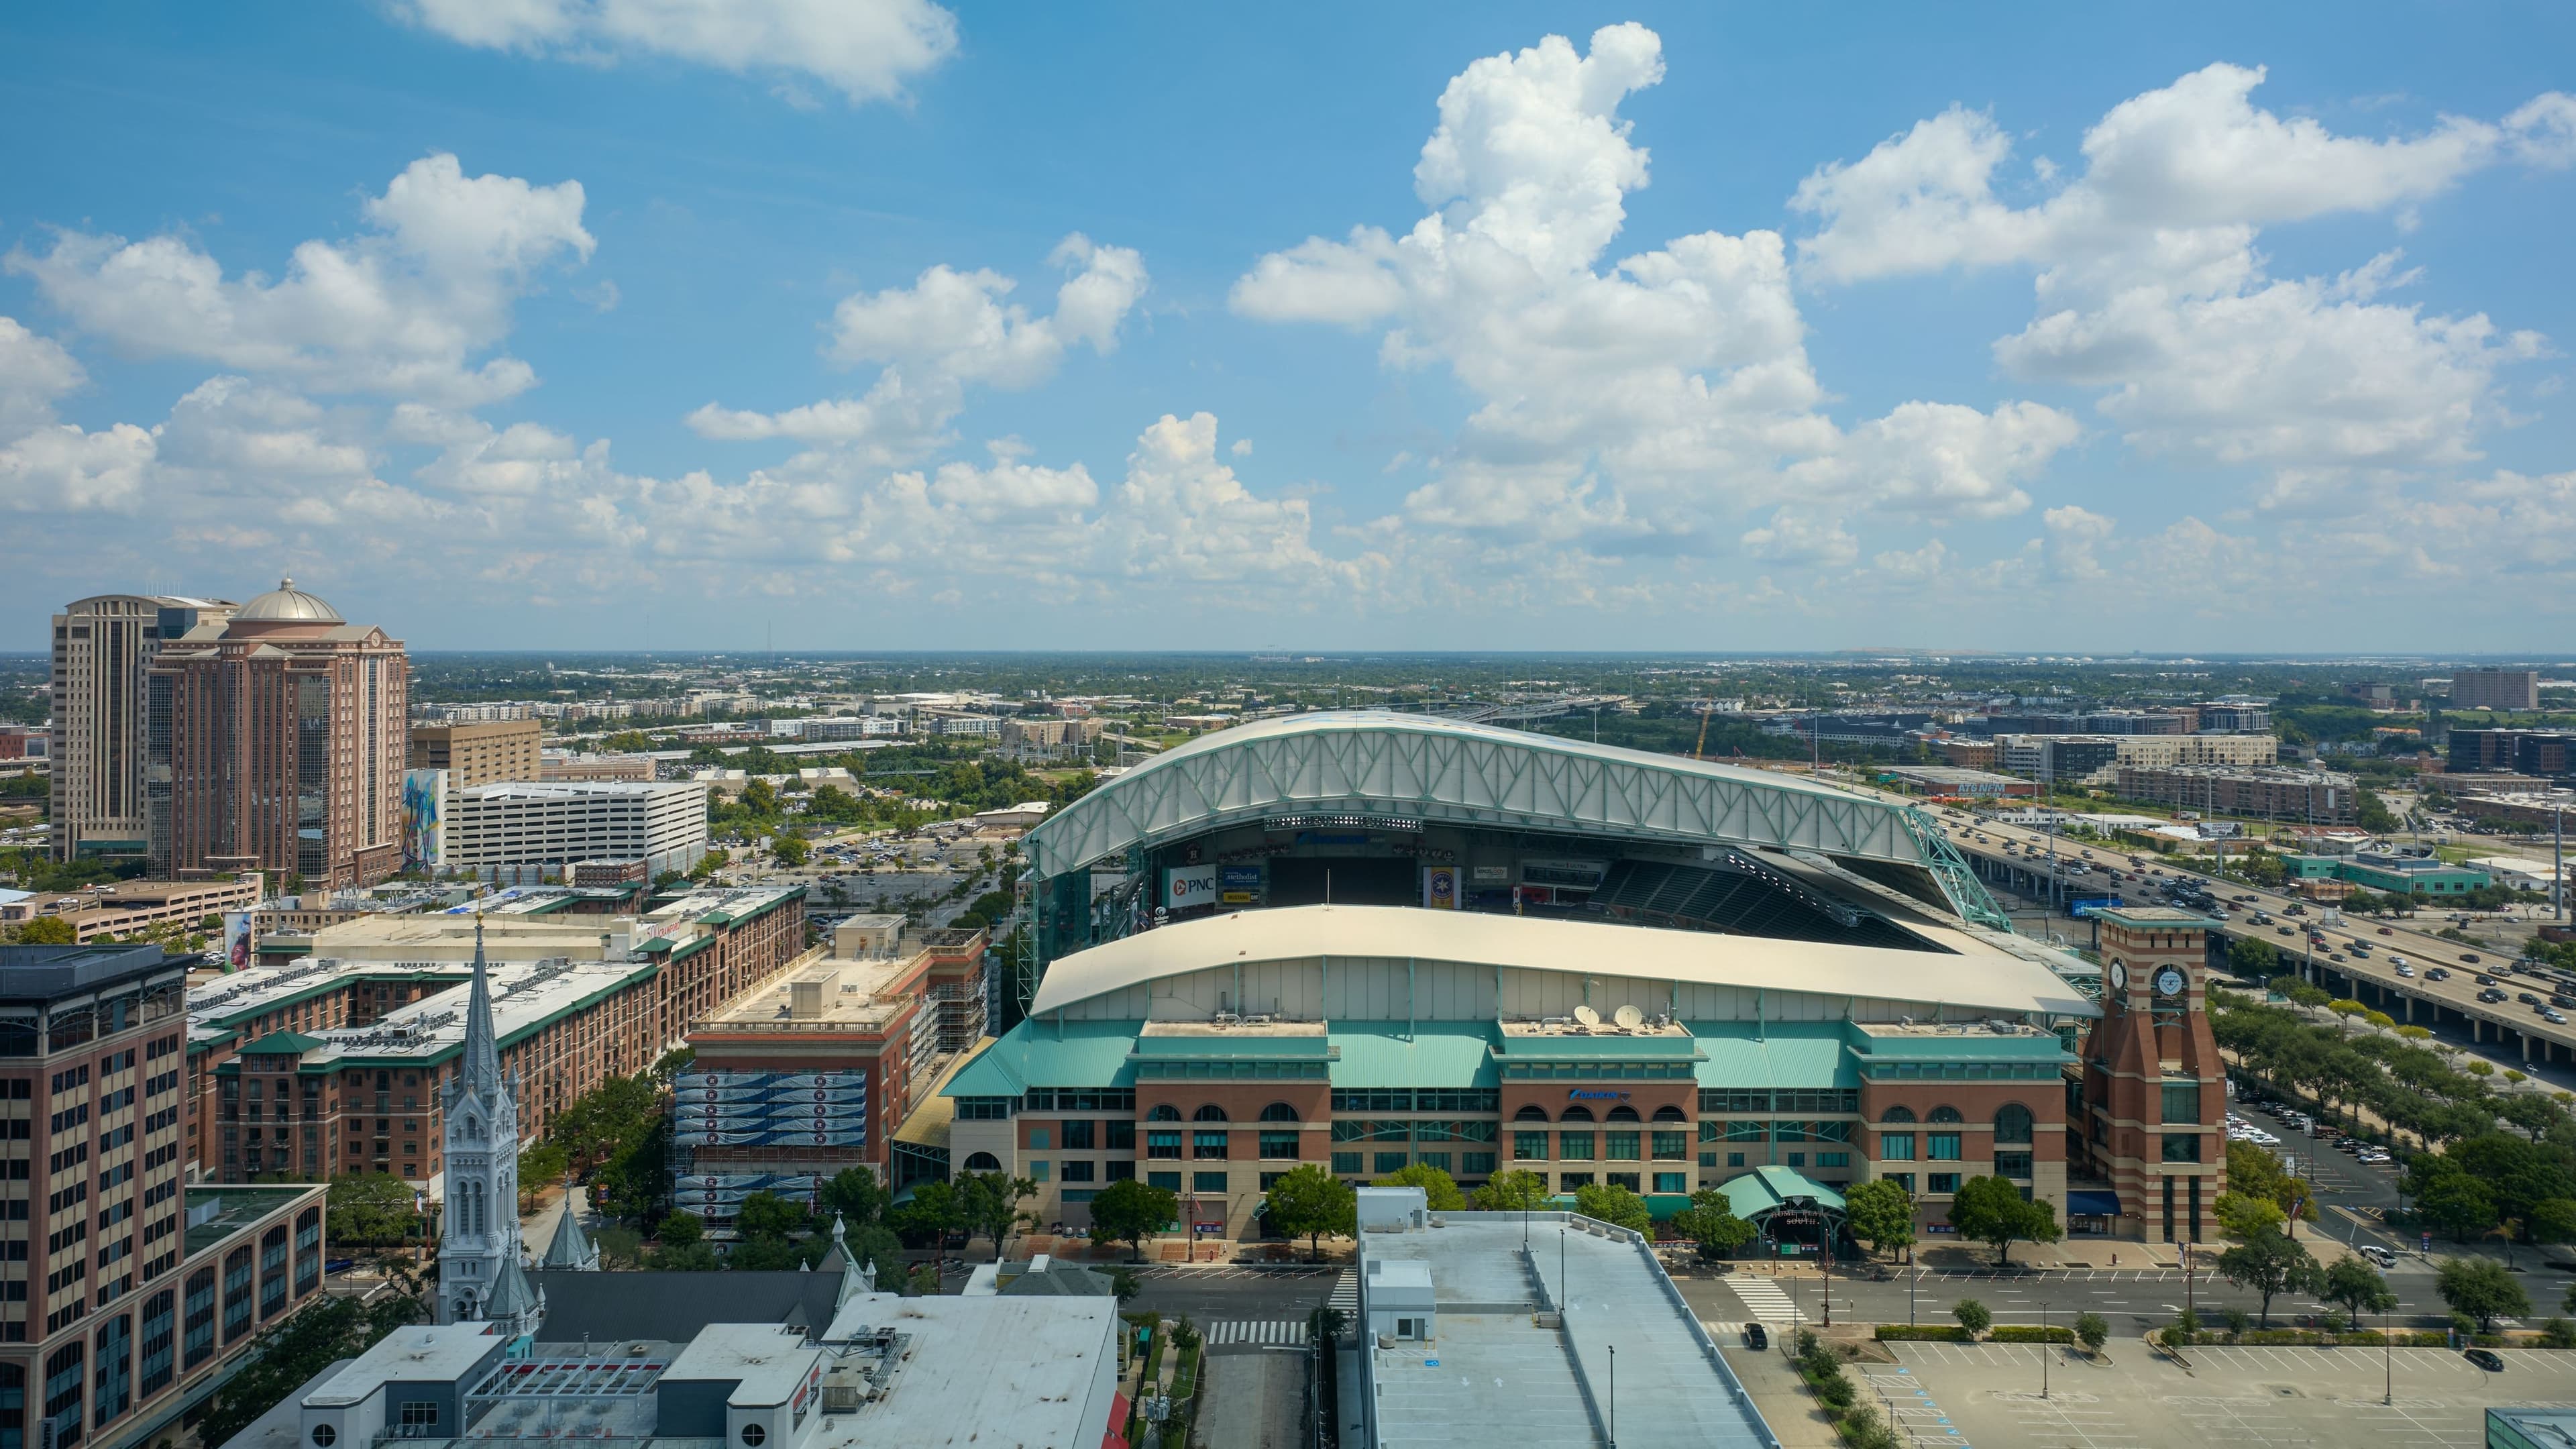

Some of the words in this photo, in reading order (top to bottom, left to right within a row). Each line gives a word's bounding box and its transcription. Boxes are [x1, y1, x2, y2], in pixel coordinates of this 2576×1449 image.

[1187, 877, 1214, 893] PNC
[1580, 1091, 1617, 1099] DAIKIN
[1771, 1210, 1796, 1218] HOME
